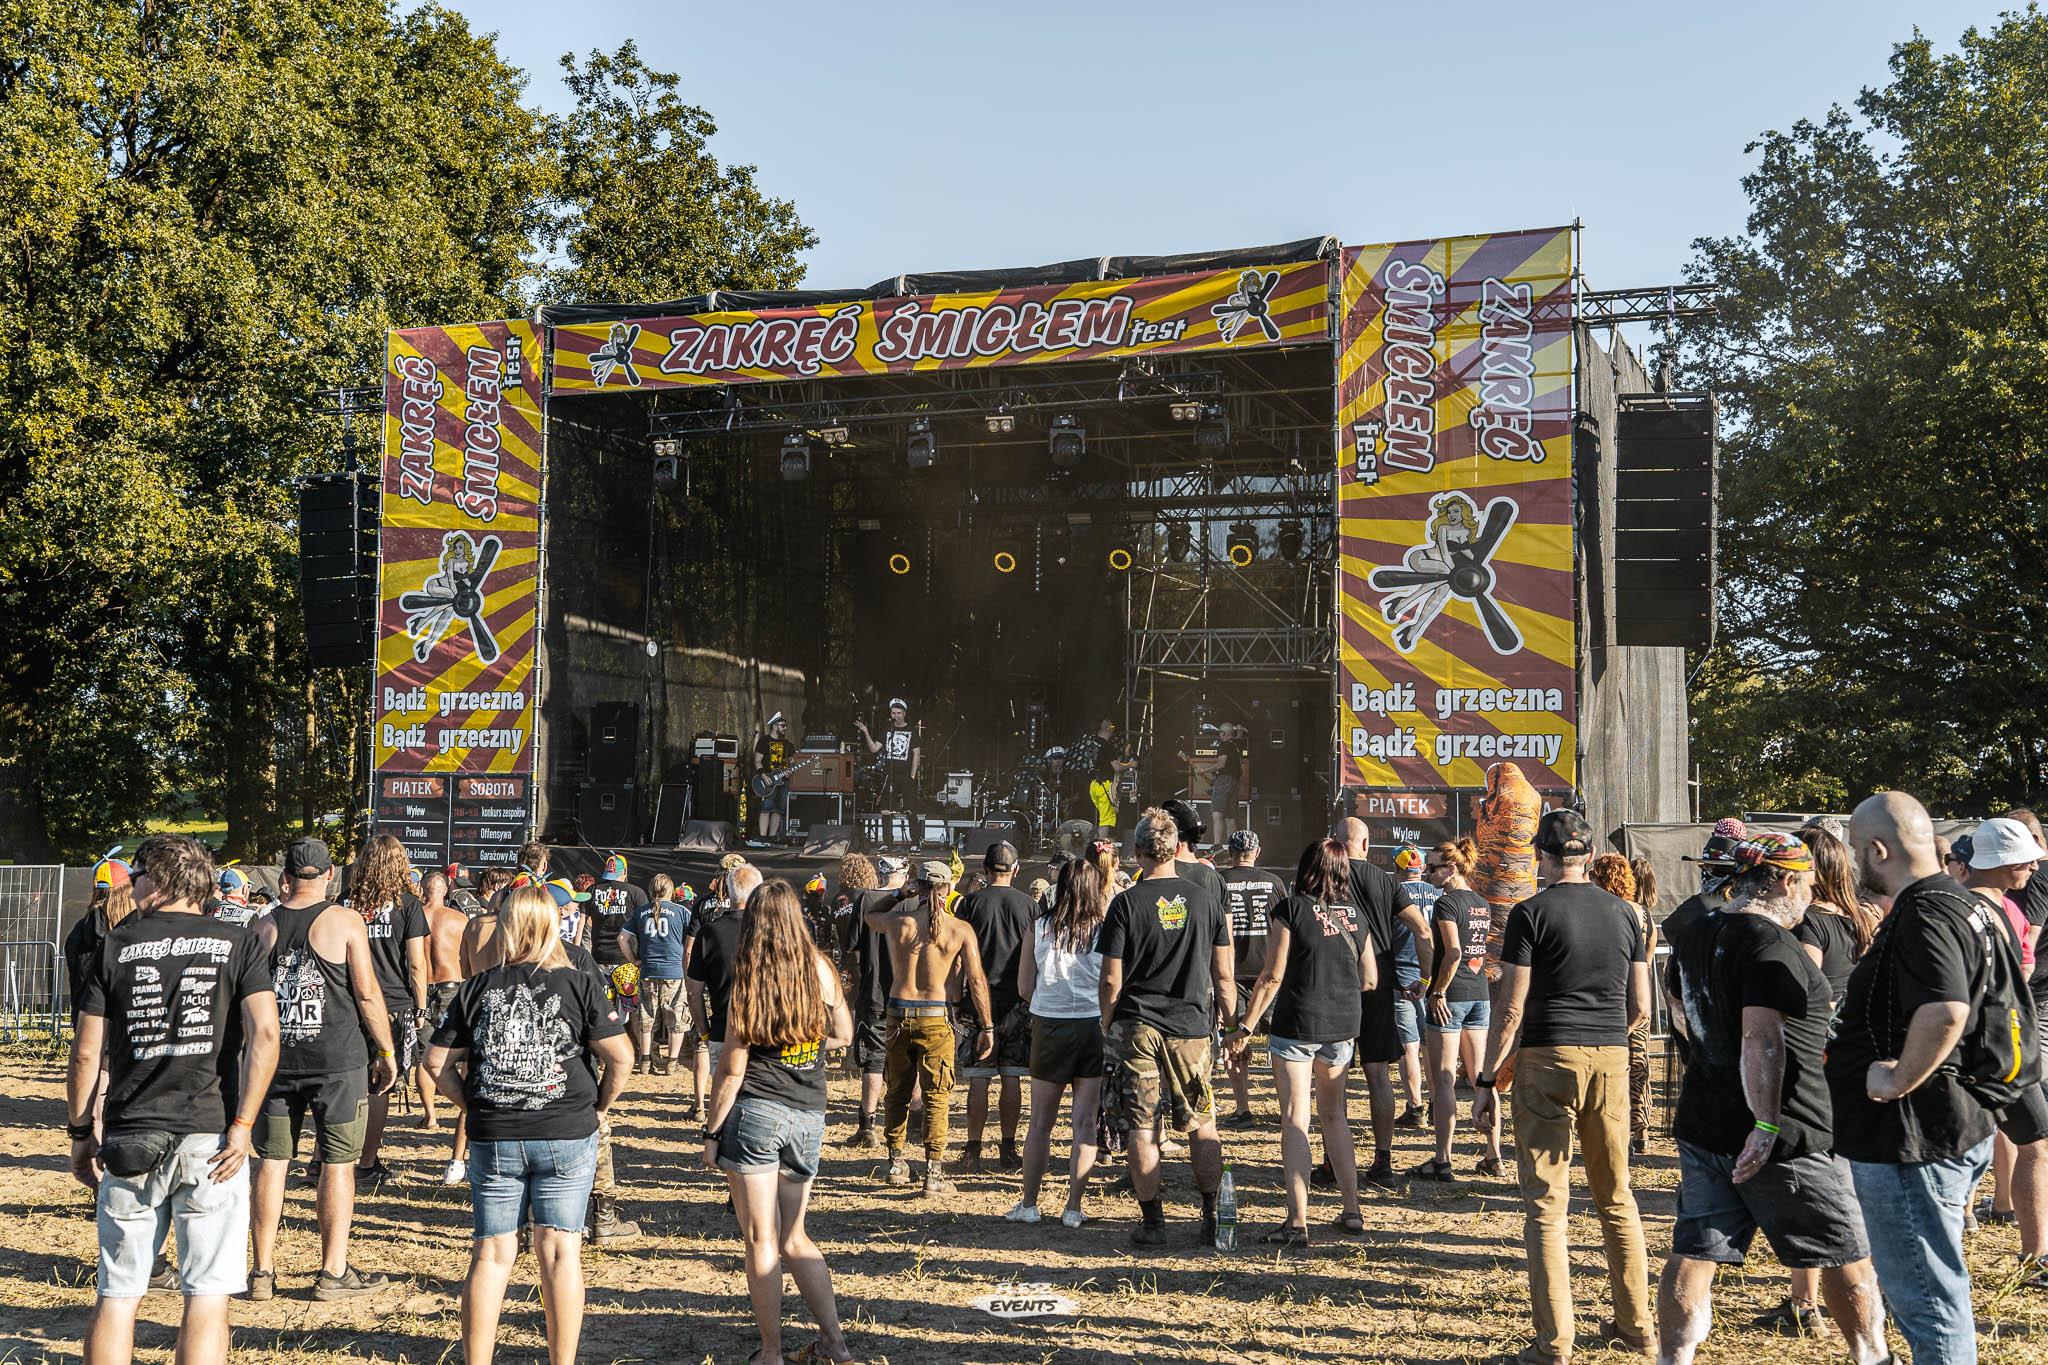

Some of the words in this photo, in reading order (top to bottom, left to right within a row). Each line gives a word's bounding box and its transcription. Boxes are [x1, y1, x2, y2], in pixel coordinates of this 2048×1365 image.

[659, 303, 864, 375] ZAKRĘĆ
[874, 295, 1135, 363] ŚMIGŁEM
[1130, 317, 1188, 348] fest
[1383, 259, 1445, 473] ŚMIGŁEM
[1468, 277, 1547, 464] ZAKRĘĆ
[394, 354, 445, 505] ZAKRĘĆ
[454, 345, 503, 522] ŚMIGŁEM
[504, 334, 523, 388] fest
[1354, 421, 1384, 486] fest
[383, 686, 427, 716] Bądź
[439, 691, 525, 717] grzeczna
[1351, 682, 1417, 718] Bądź
[1435, 687, 1563, 720] grzeczna
[382, 723, 426, 752] Bądź
[438, 728, 524, 755] grzeczny
[1351, 727, 1417, 763] Bądź
[1435, 733, 1564, 766] grzeczny
[392, 781, 433, 797] PIĄTEK
[470, 782, 515, 796] SOBOTA
[406, 805, 426, 818] Wylew
[481, 806, 502, 818] konkurs
[1369, 798, 1430, 817] PIĄTEK
[406, 827, 428, 838] Prawda
[480, 828, 512, 841] Offensywa
[1392, 826, 1421, 841] Wylew
[480, 850, 508, 863] Garażowy
[509, 850, 519, 864] Raj
[645, 917, 669, 937] 40
[118, 938, 172, 963] ZAKRĘĆ
[132, 984, 162, 994] PRAWDA
[504, 1020, 536, 1043] 30
